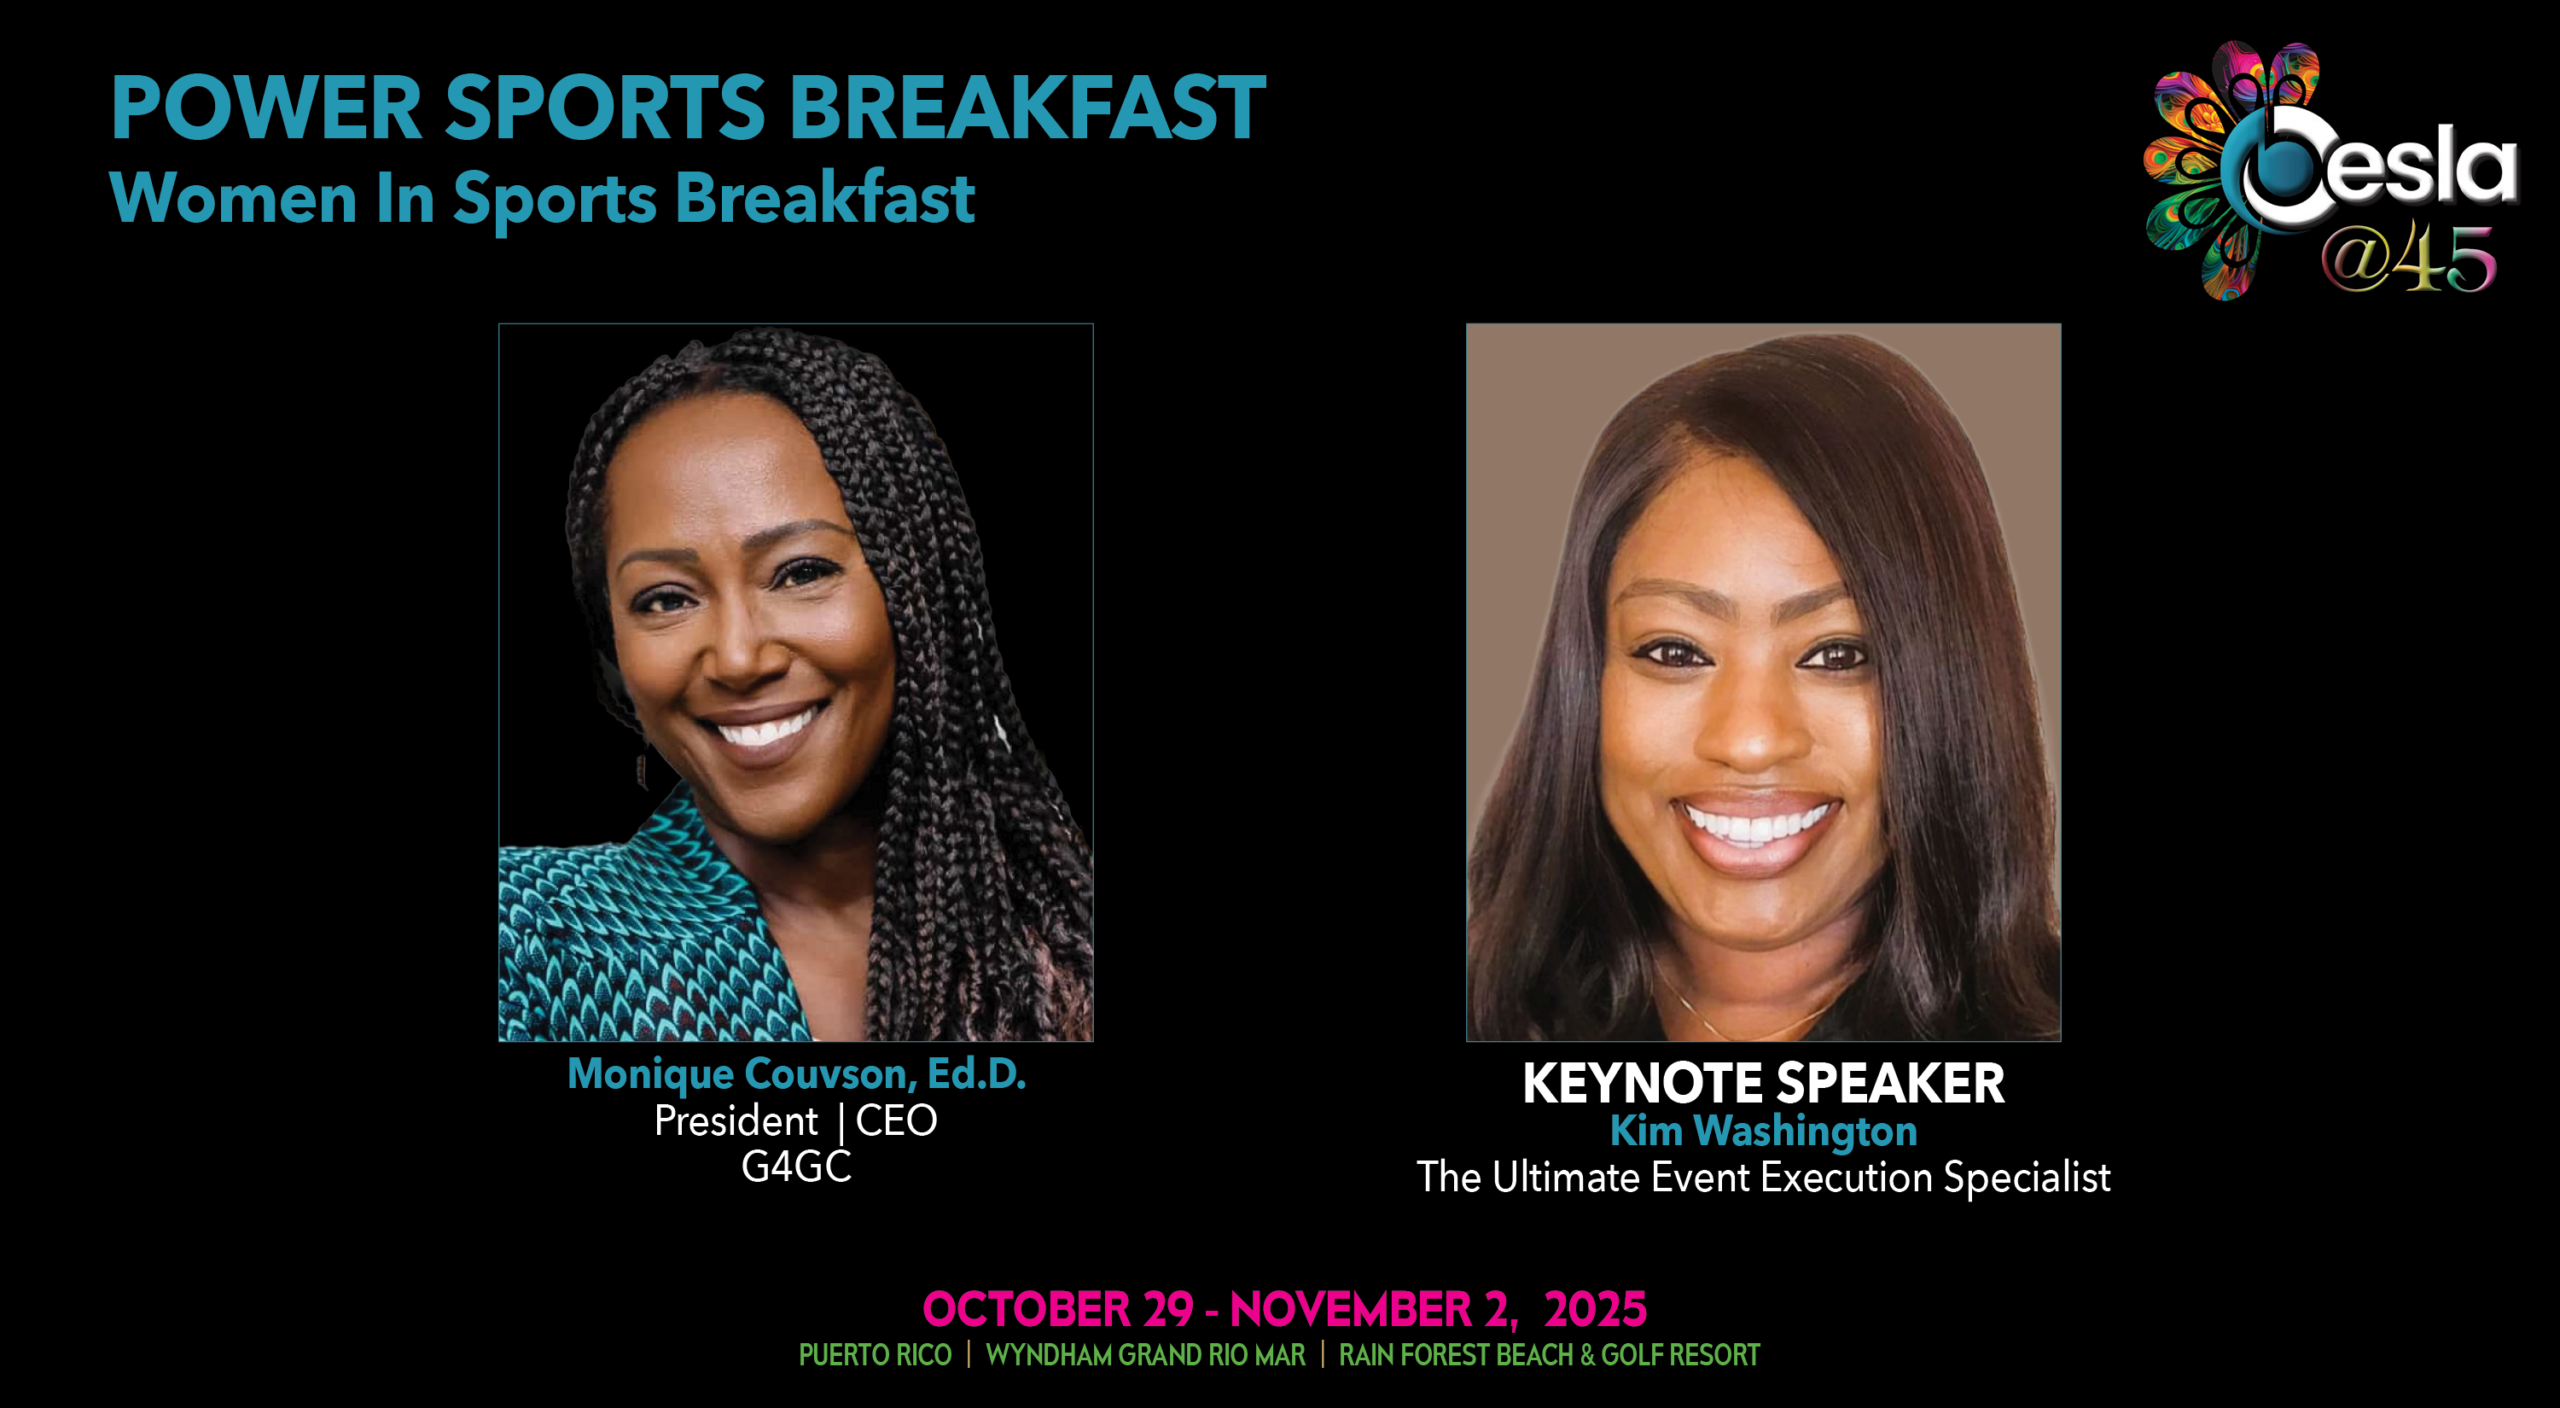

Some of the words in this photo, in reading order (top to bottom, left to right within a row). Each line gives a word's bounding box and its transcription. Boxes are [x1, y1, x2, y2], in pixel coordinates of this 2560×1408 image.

[114, 73, 423, 140] POWER
[445, 73, 764, 140] SPORTS
[793, 73, 1266, 140] BREAKFAST
[109, 171, 355, 223] Women
[379, 171, 433, 222] In
[454, 170, 656, 239] Sports
[678, 166, 975, 223] Breakfast
[2321, 217, 2498, 293] @45
[569, 1055, 734, 1099] Monique
[746, 1056, 917, 1093] Couvson,
[930, 1055, 1025, 1089] Ed.D.
[1525, 1060, 1762, 1104] KEYNOTE
[1777, 1060, 2005, 1104] SPEAKER
[657, 1102, 818, 1136] President
[857, 1103, 937, 1136] CEO
[1612, 1113, 1682, 1145] Kim
[1693, 1112, 1916, 1156] Washington
[742, 1149, 851, 1182] G4GC
[1417, 1158, 1481, 1192] The
[1495, 1158, 1640, 1192] Ultimate
[1654, 1160, 1750, 1192] Event
[1763, 1160, 1931, 1192] Execution
[1945, 1158, 2111, 1202] Specialist
[924, 1290, 1131, 1327] OCTOBER
[1143, 1290, 1193, 1326] 29
[1232, 1290, 1472, 1327] NOVEMBER
[1485, 1290, 1518, 1333] 2,
[1544, 1290, 1647, 1327] 2025
[800, 1343, 889, 1365] PUERTO
[898, 1343, 952, 1365] RICO
[986, 1343, 1111, 1365] WYNDHAM
[1119, 1343, 1202, 1365] GRAND
[1210, 1343, 1248, 1365] RIO
[1256, 1343, 1306, 1365] MAR
[1341, 1343, 1393, 1365] RAIN
[1402, 1343, 1490, 1365] FOREST
[1498, 1343, 1572, 1365] BEACH
[1581, 1343, 1596, 1365] &
[1602, 1343, 1663, 1365] GOLF
[1671, 1343, 1761, 1365] RESORT
